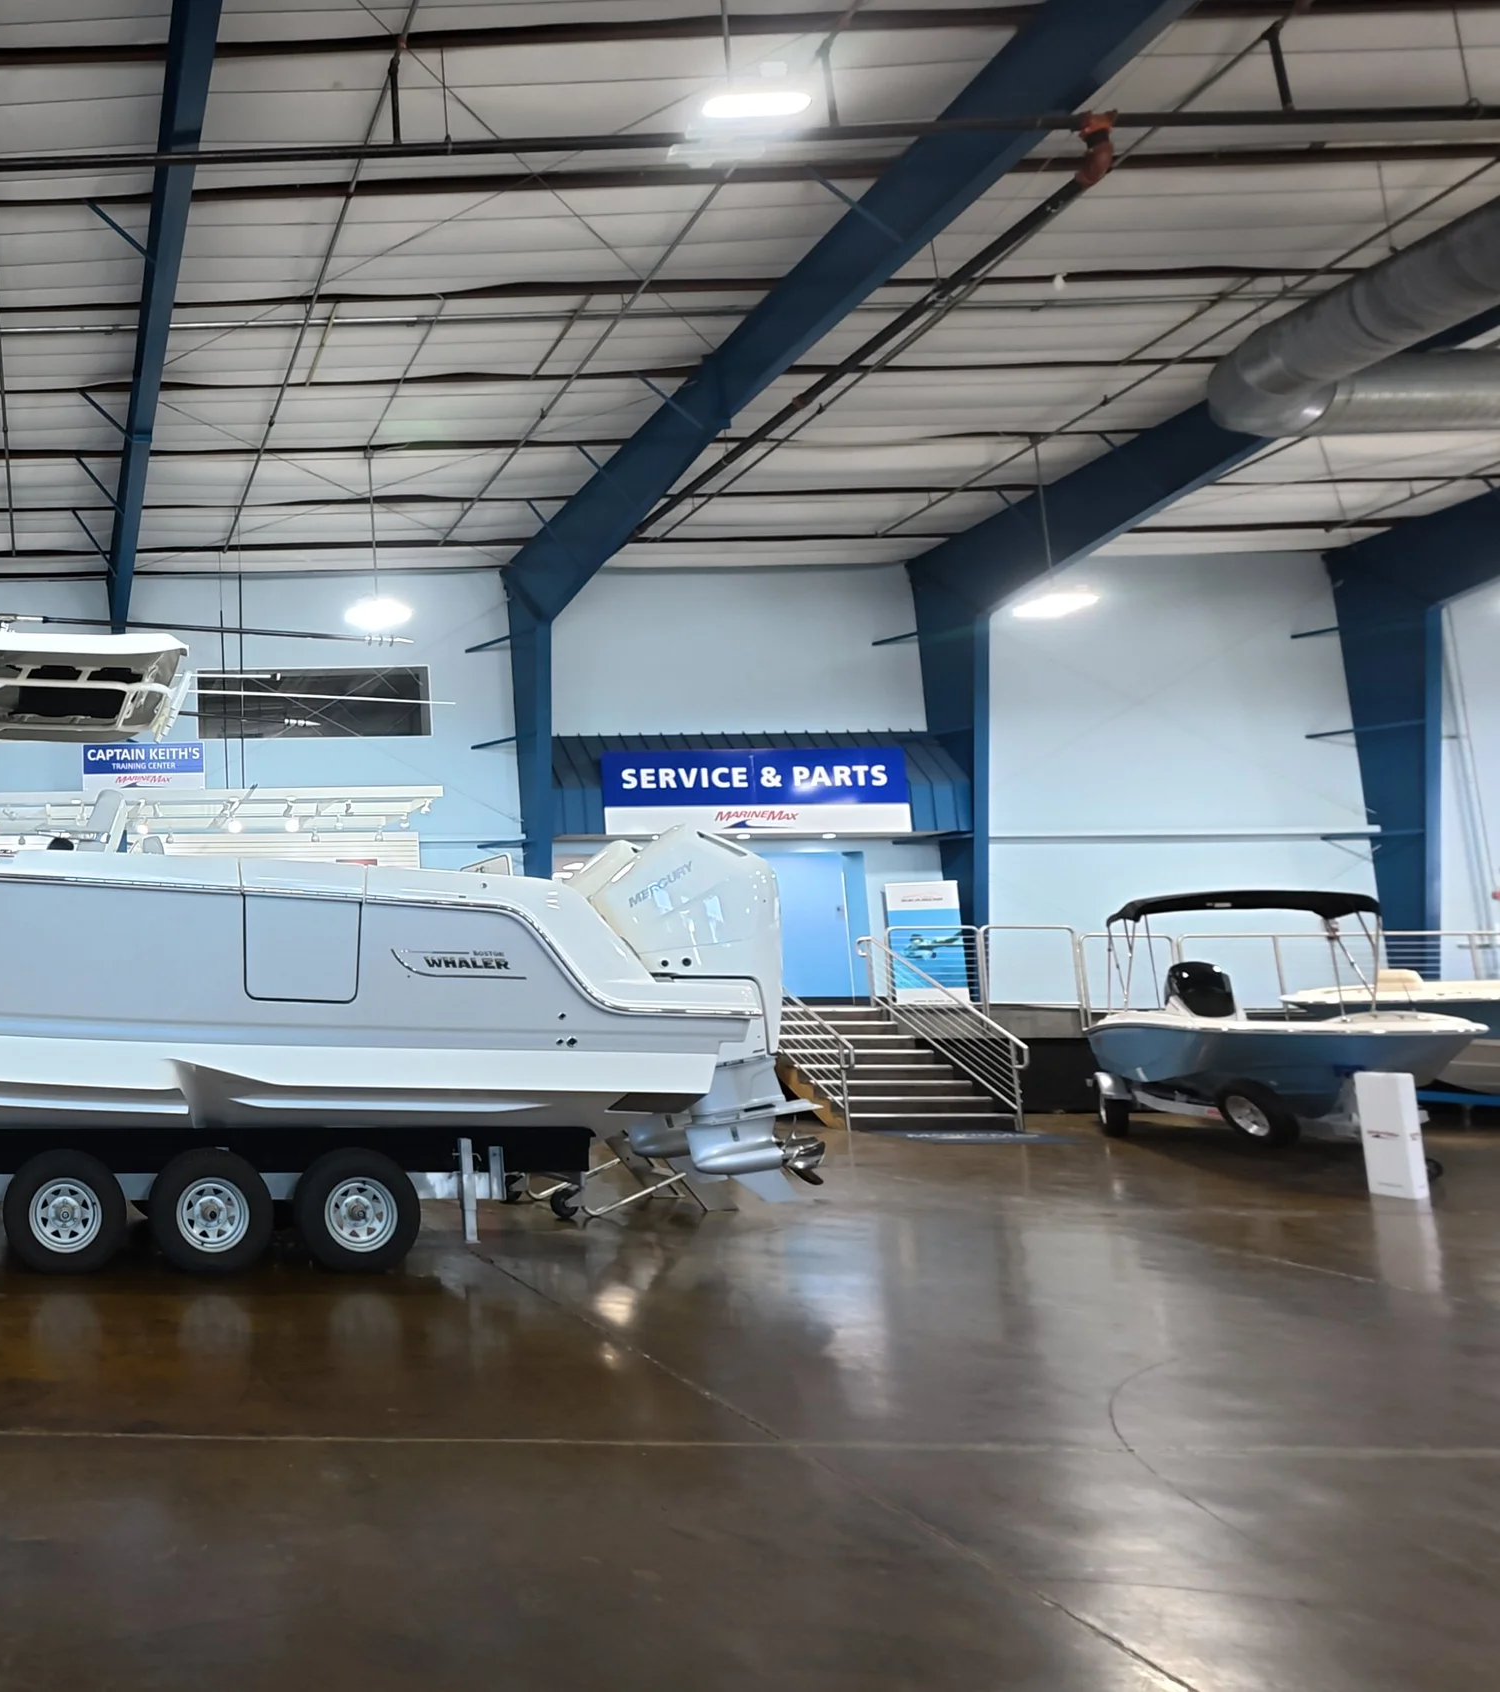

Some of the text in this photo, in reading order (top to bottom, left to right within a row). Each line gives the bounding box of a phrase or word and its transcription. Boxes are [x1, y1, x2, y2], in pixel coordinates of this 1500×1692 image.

[87, 747, 200, 761] CAPTAIN KEITH'S
[112, 762, 176, 770] TRAINING CENTER
[621, 765, 888, 789] SERVICE & PARTS
[628, 861, 692, 908] MERCURY
[423, 956, 511, 970] WHALER
